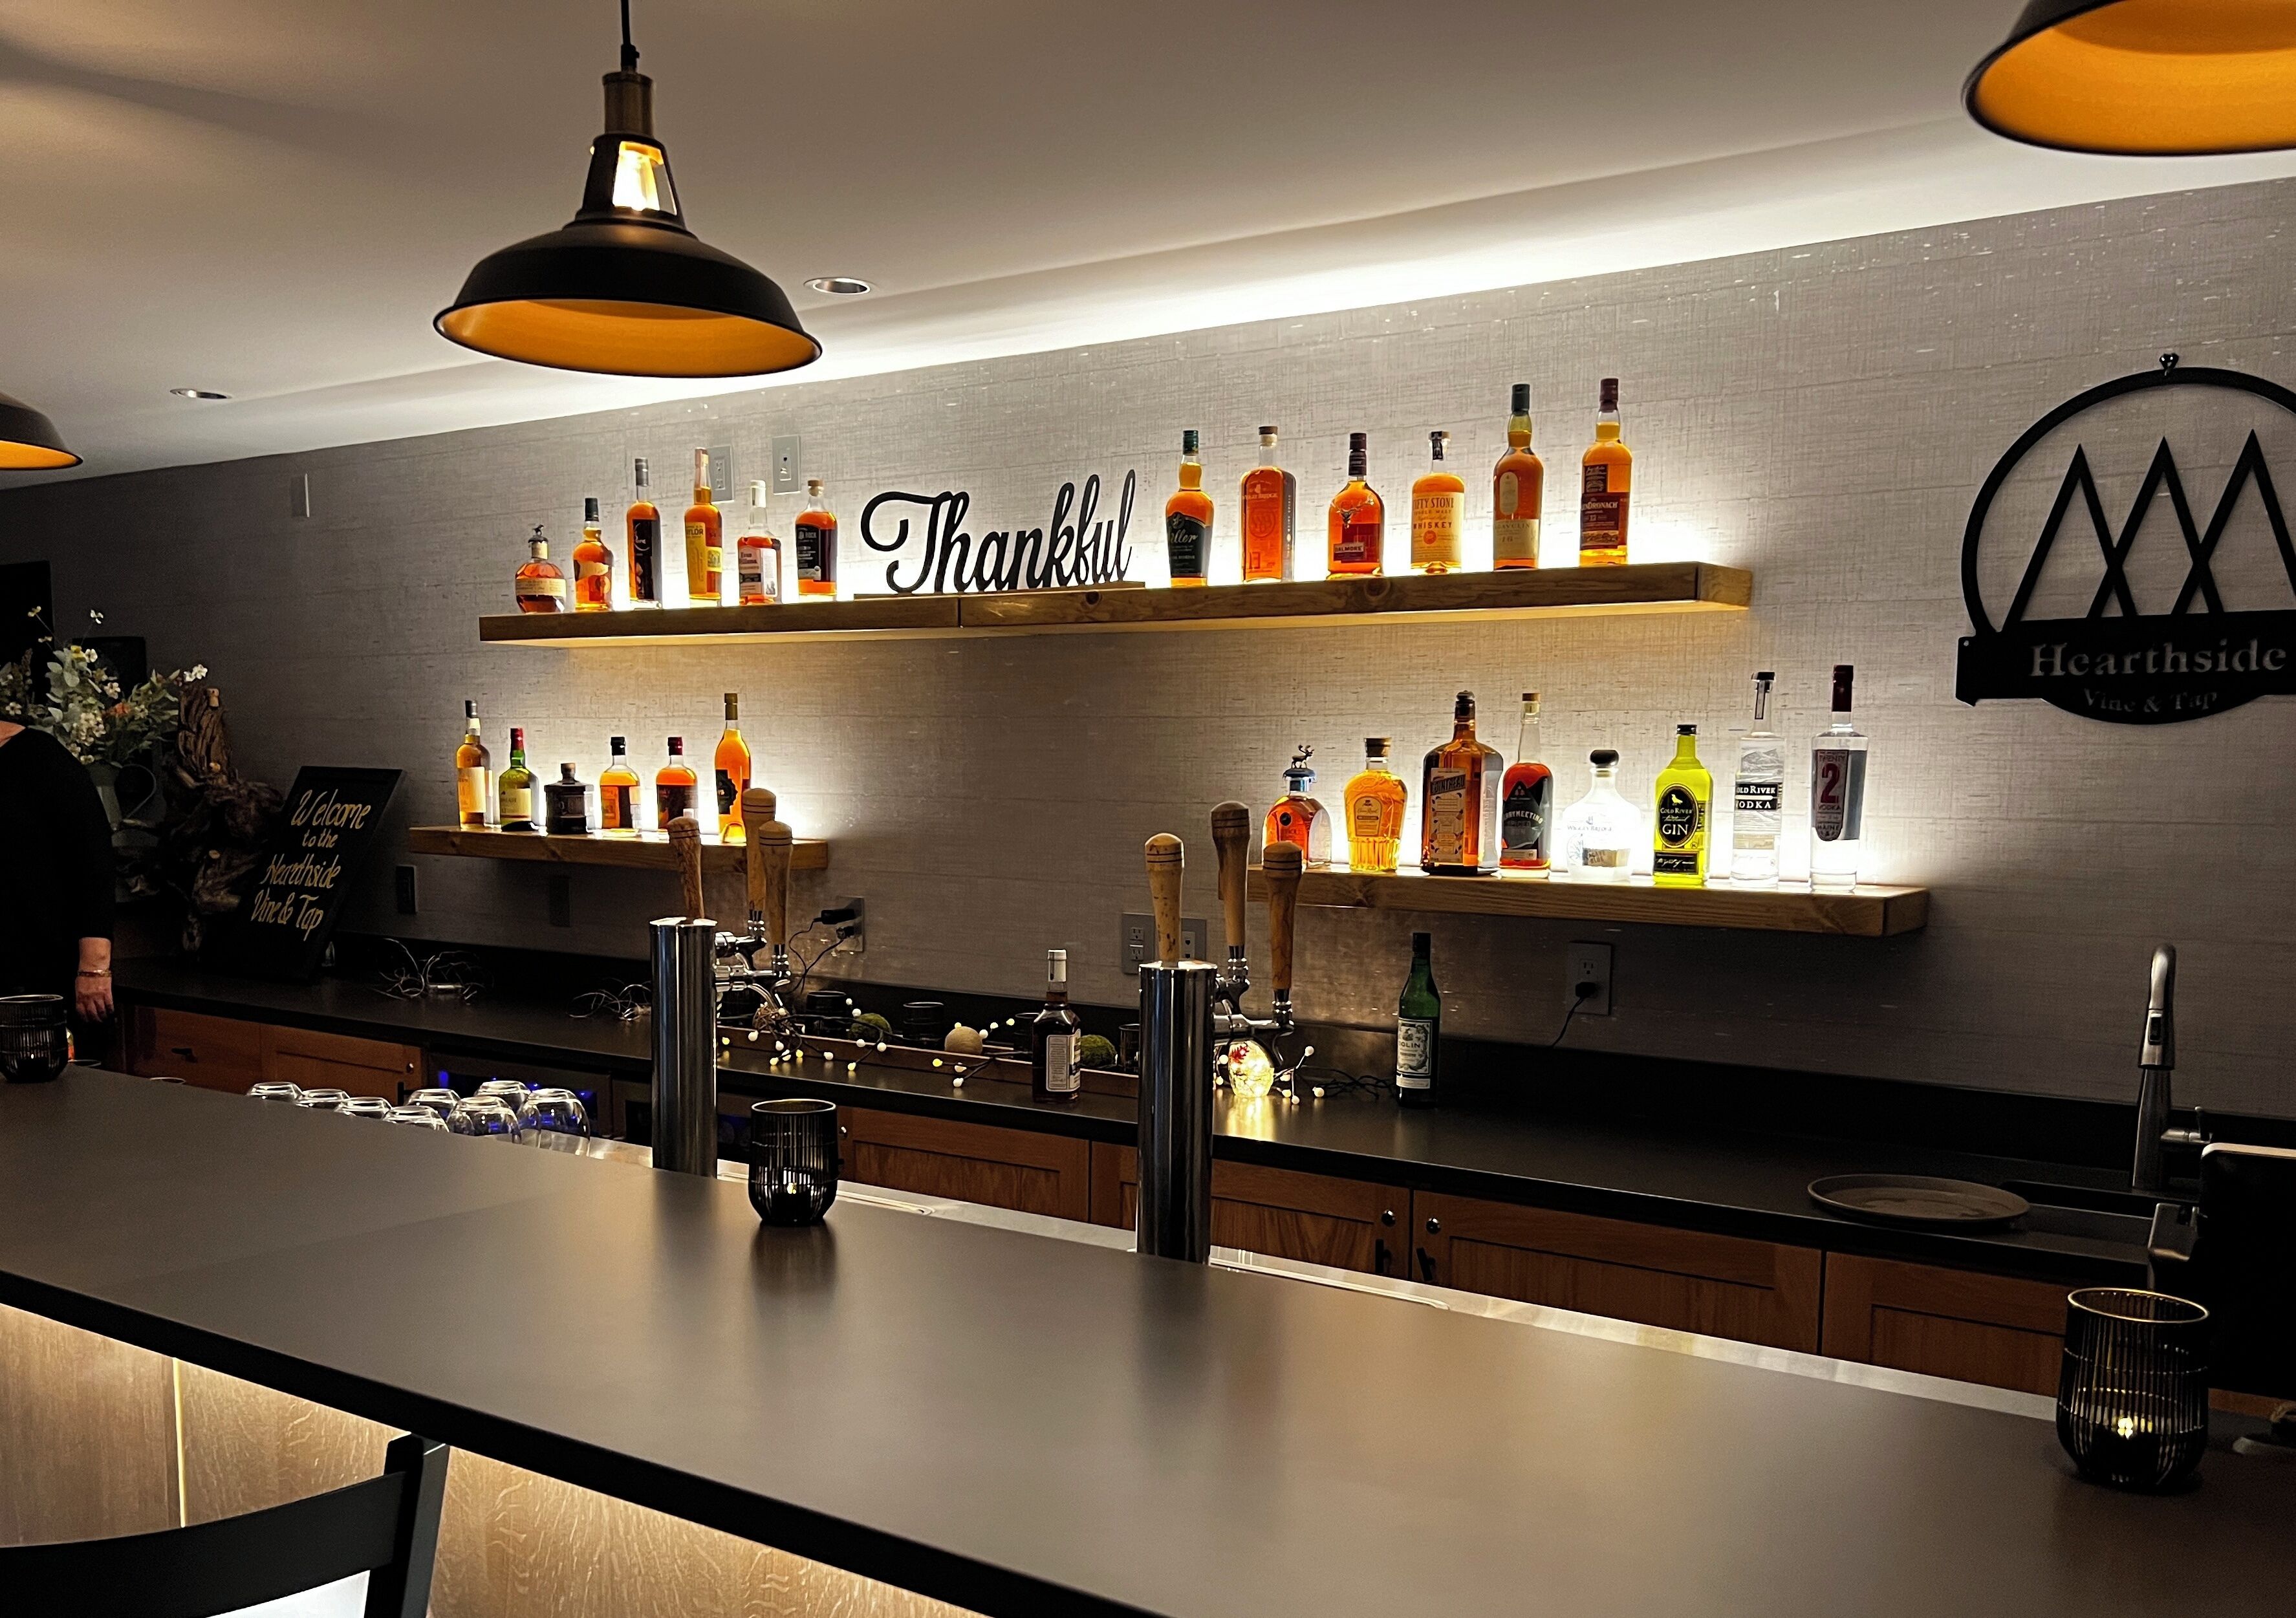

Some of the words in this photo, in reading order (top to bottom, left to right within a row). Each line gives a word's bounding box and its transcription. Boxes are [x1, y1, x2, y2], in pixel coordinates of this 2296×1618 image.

[860, 469, 1136, 593] Thankful
[2028, 637, 2288, 677] Hearthside
[2083, 687, 2137, 713] Vine
[2143, 694, 2162, 713] &
[2169, 689, 2218, 711] Tap
[1821, 763, 1840, 803] 2
[290, 788, 372, 830] Welcome
[301, 828, 317, 847] to
[318, 828, 339, 848] the
[1662, 824, 1689, 836] GIN
[259, 853, 341, 889] Hearthside
[250, 887, 280, 923] Vine
[277, 892, 296, 925] &
[296, 894, 325, 942] Tap
